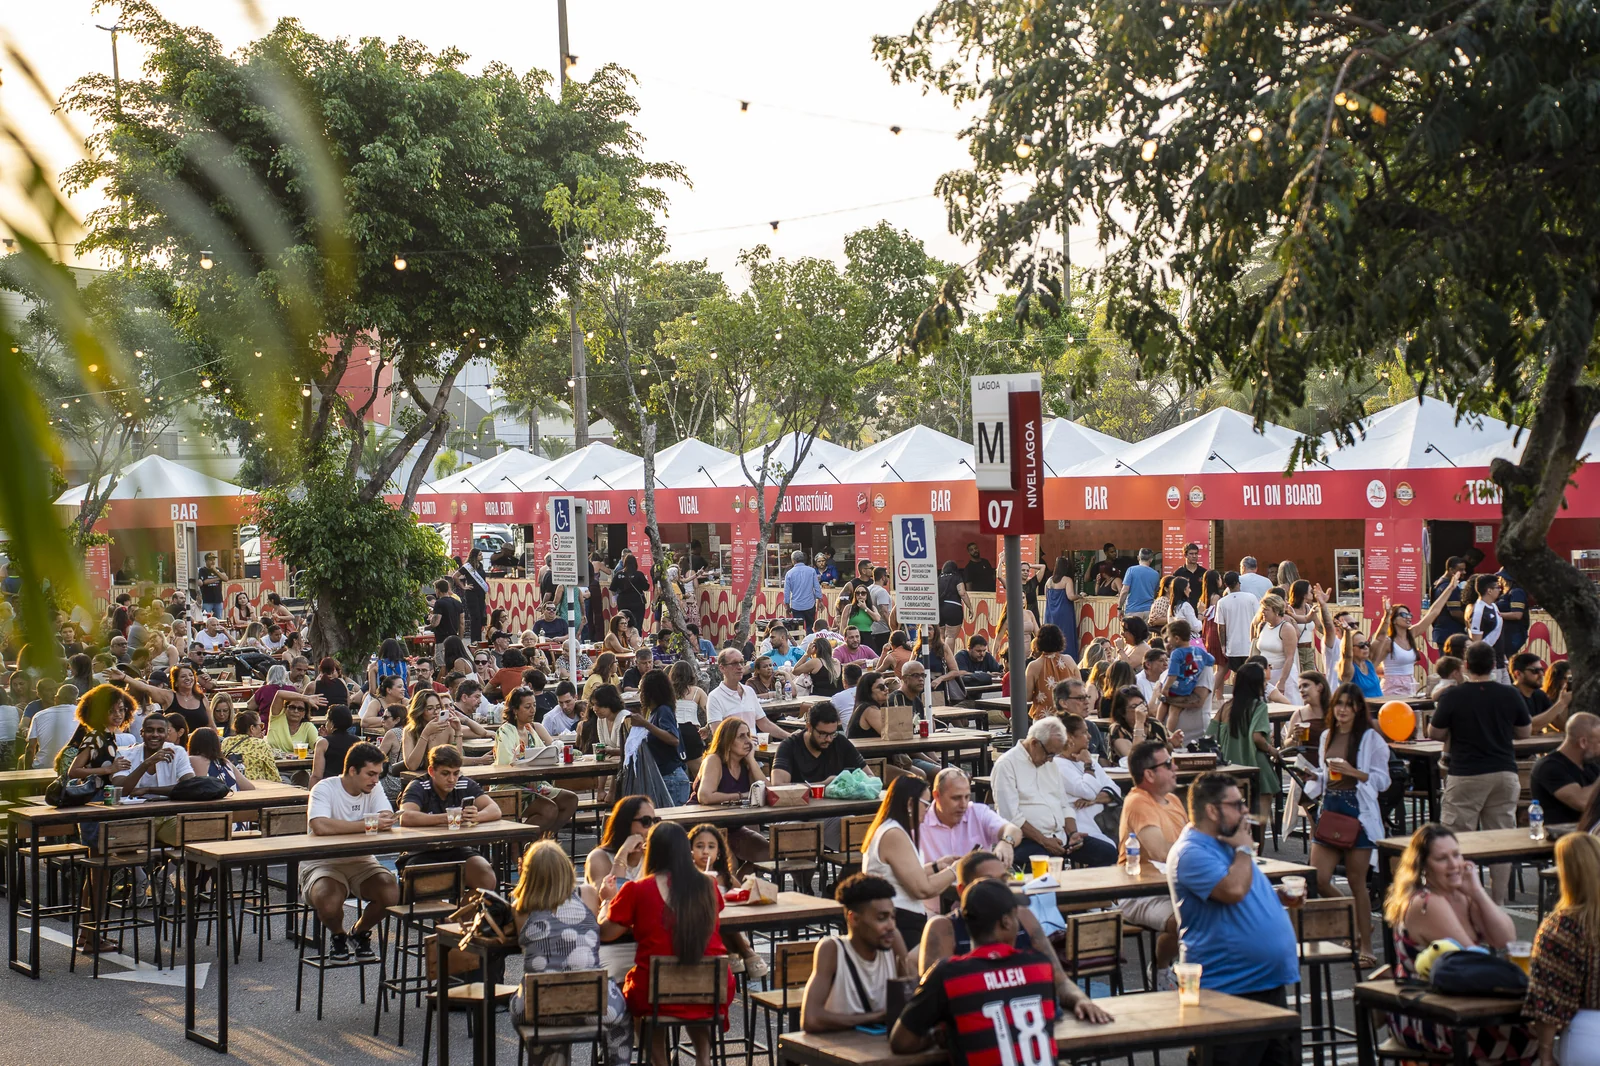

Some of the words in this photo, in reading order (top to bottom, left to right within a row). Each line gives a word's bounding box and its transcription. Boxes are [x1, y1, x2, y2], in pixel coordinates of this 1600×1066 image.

[977, 380, 1001, 391] LAGOA
[977, 421, 1005, 464] M
[1025, 420, 1036, 468] LAGOA
[794, 490, 833, 512] CRISTÓVÃO
[930, 490, 951, 512] BAR
[1026, 472, 1037, 508] NÍVEL
[1085, 486, 1108, 510] BAR
[1242, 485, 1260, 506] PLI
[1264, 484, 1281, 506] ON
[1285, 483, 1323, 506] BOARD
[170, 503, 199, 521] BAR
[500, 501, 515, 516] EXTRA
[678, 495, 700, 515] VIGAL
[987, 499, 1014, 529] 07
[901, 566, 907, 576] E
[982, 994, 1053, 1066] 18
